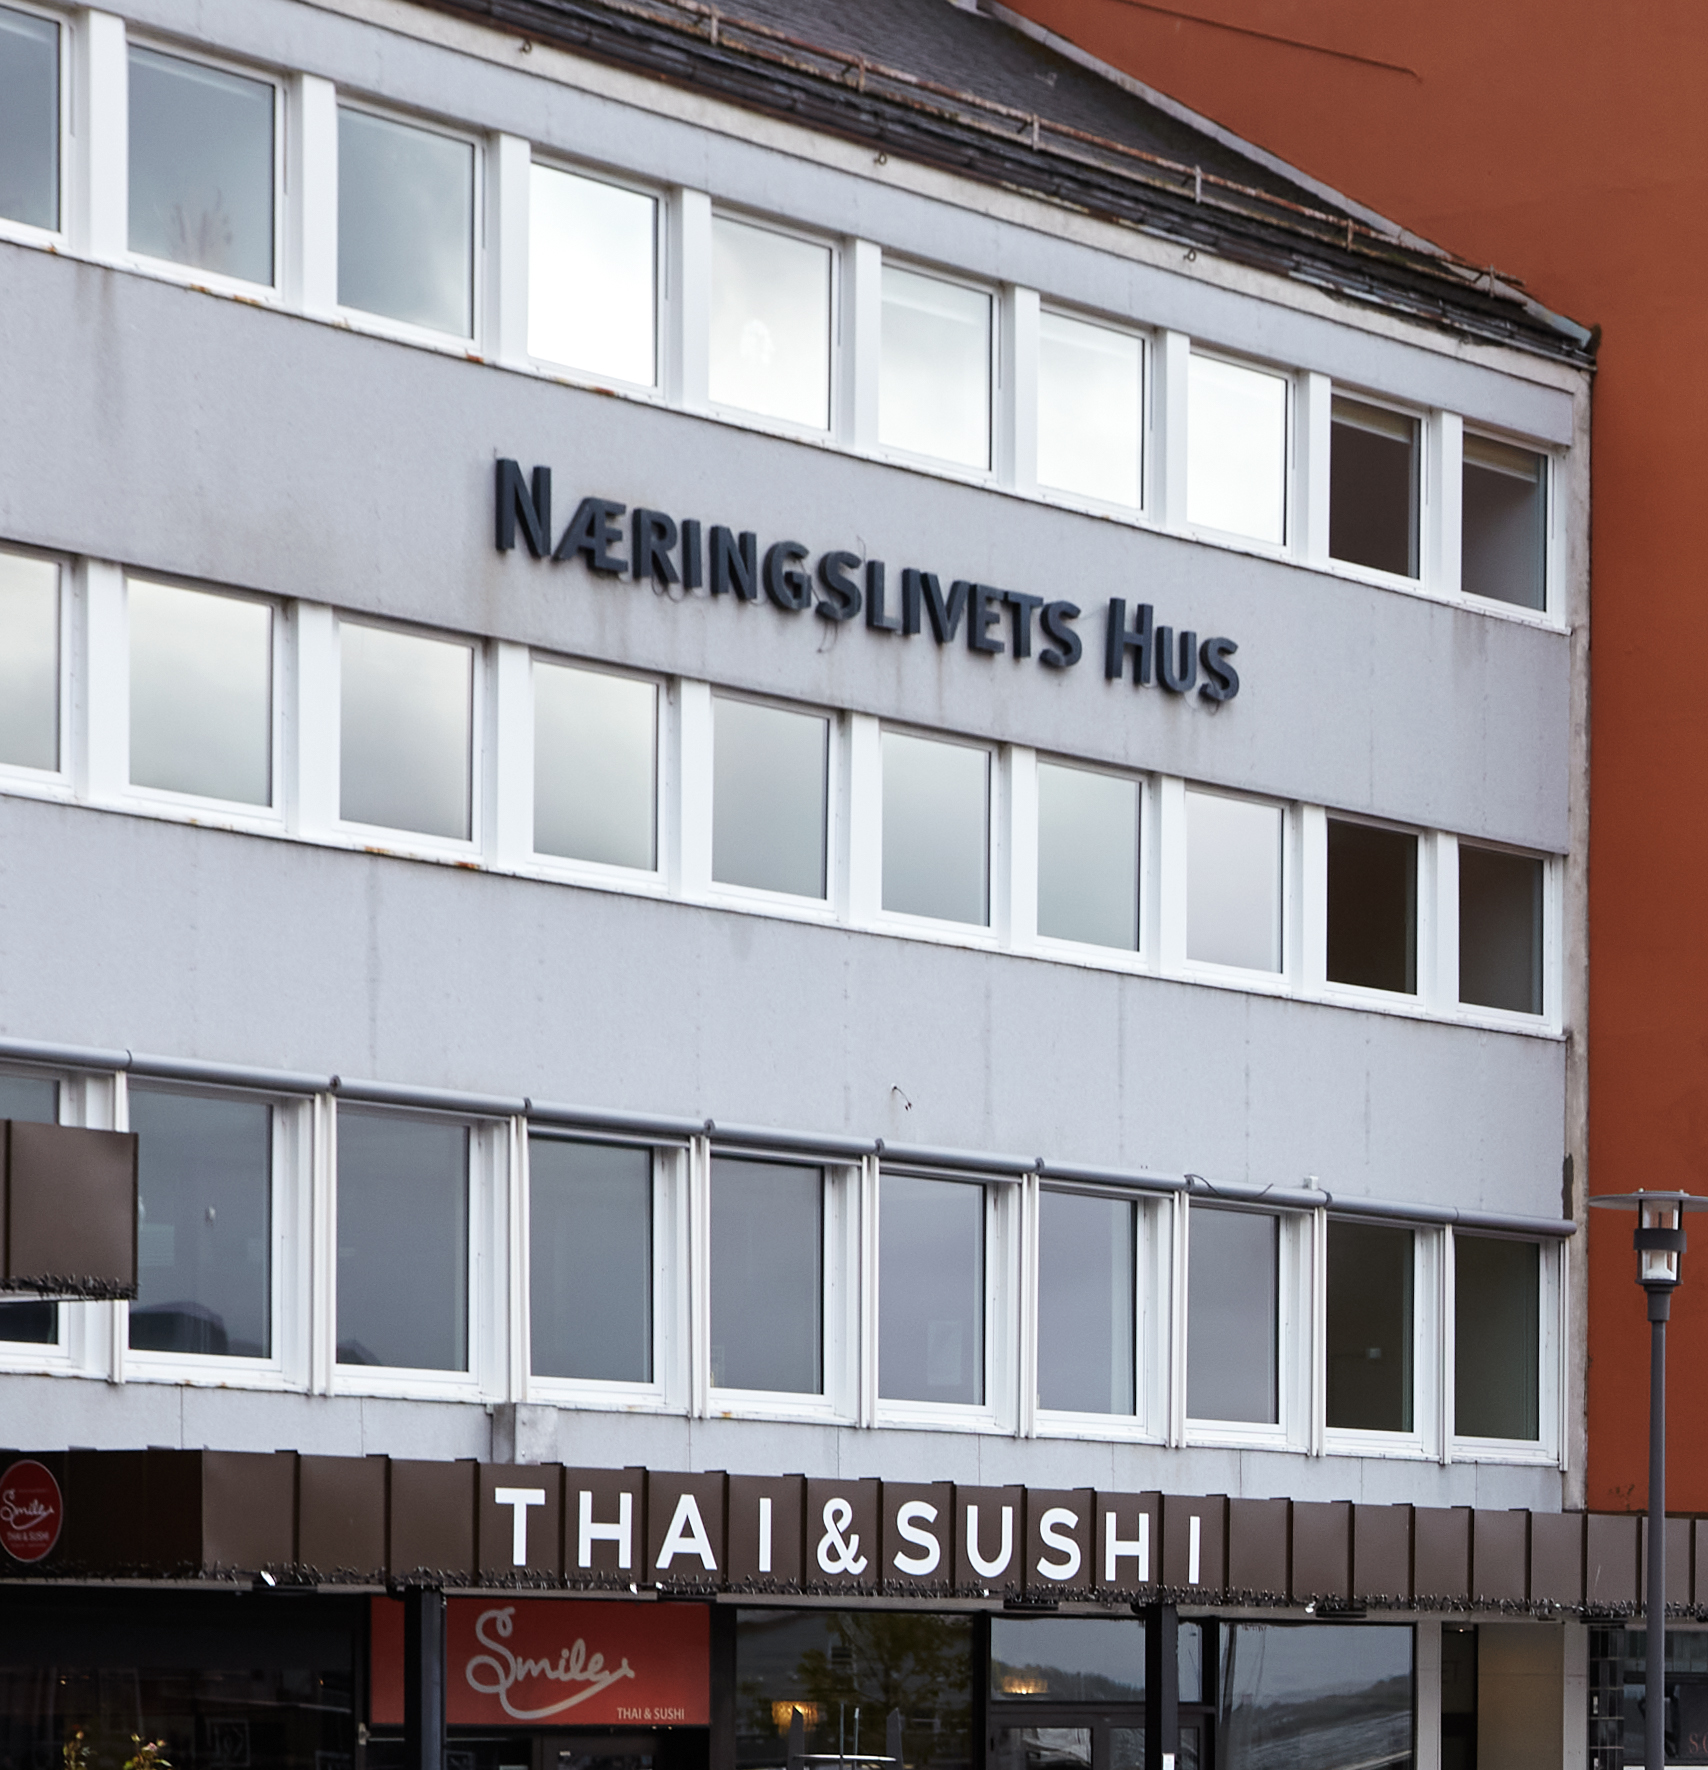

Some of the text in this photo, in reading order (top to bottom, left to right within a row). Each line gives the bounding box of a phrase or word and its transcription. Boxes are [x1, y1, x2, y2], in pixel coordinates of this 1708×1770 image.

[465, 1606, 635, 1720] Smile
[617, 1707, 685, 1720] THAI & SUSHI
